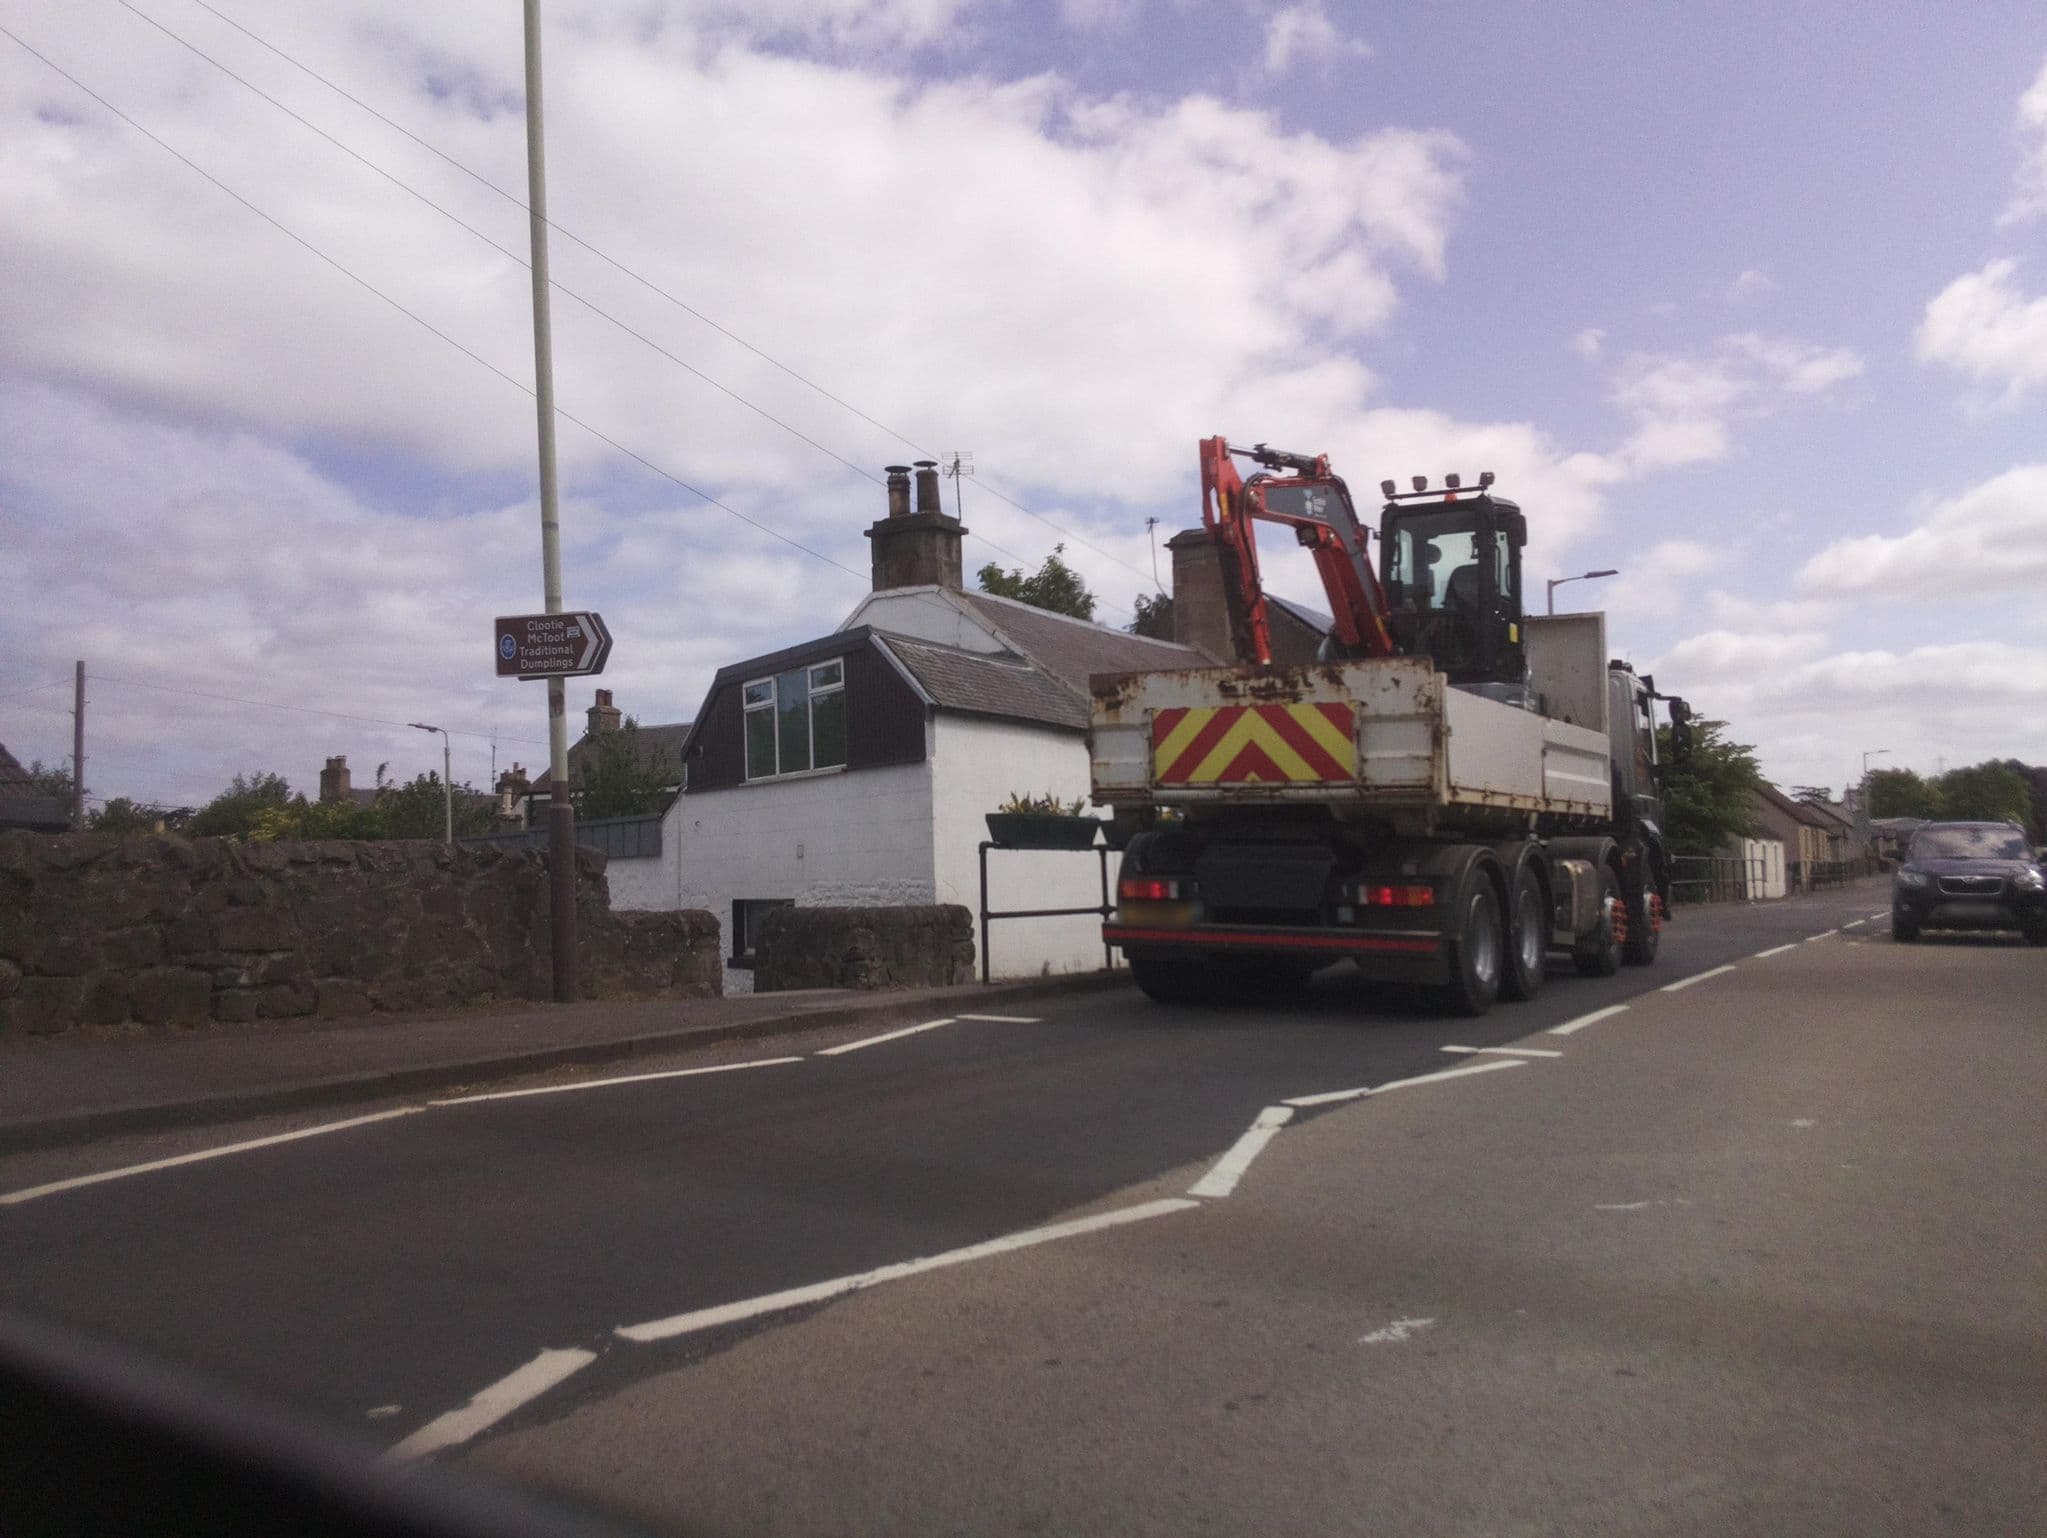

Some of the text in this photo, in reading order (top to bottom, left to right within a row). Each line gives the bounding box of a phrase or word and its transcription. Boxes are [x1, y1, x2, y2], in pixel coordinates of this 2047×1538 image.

[527, 620, 564, 631] Clootie
[528, 632, 565, 643] McToot
[520, 643, 573, 656] Traditional
[521, 658, 574, 669] Dumplings
